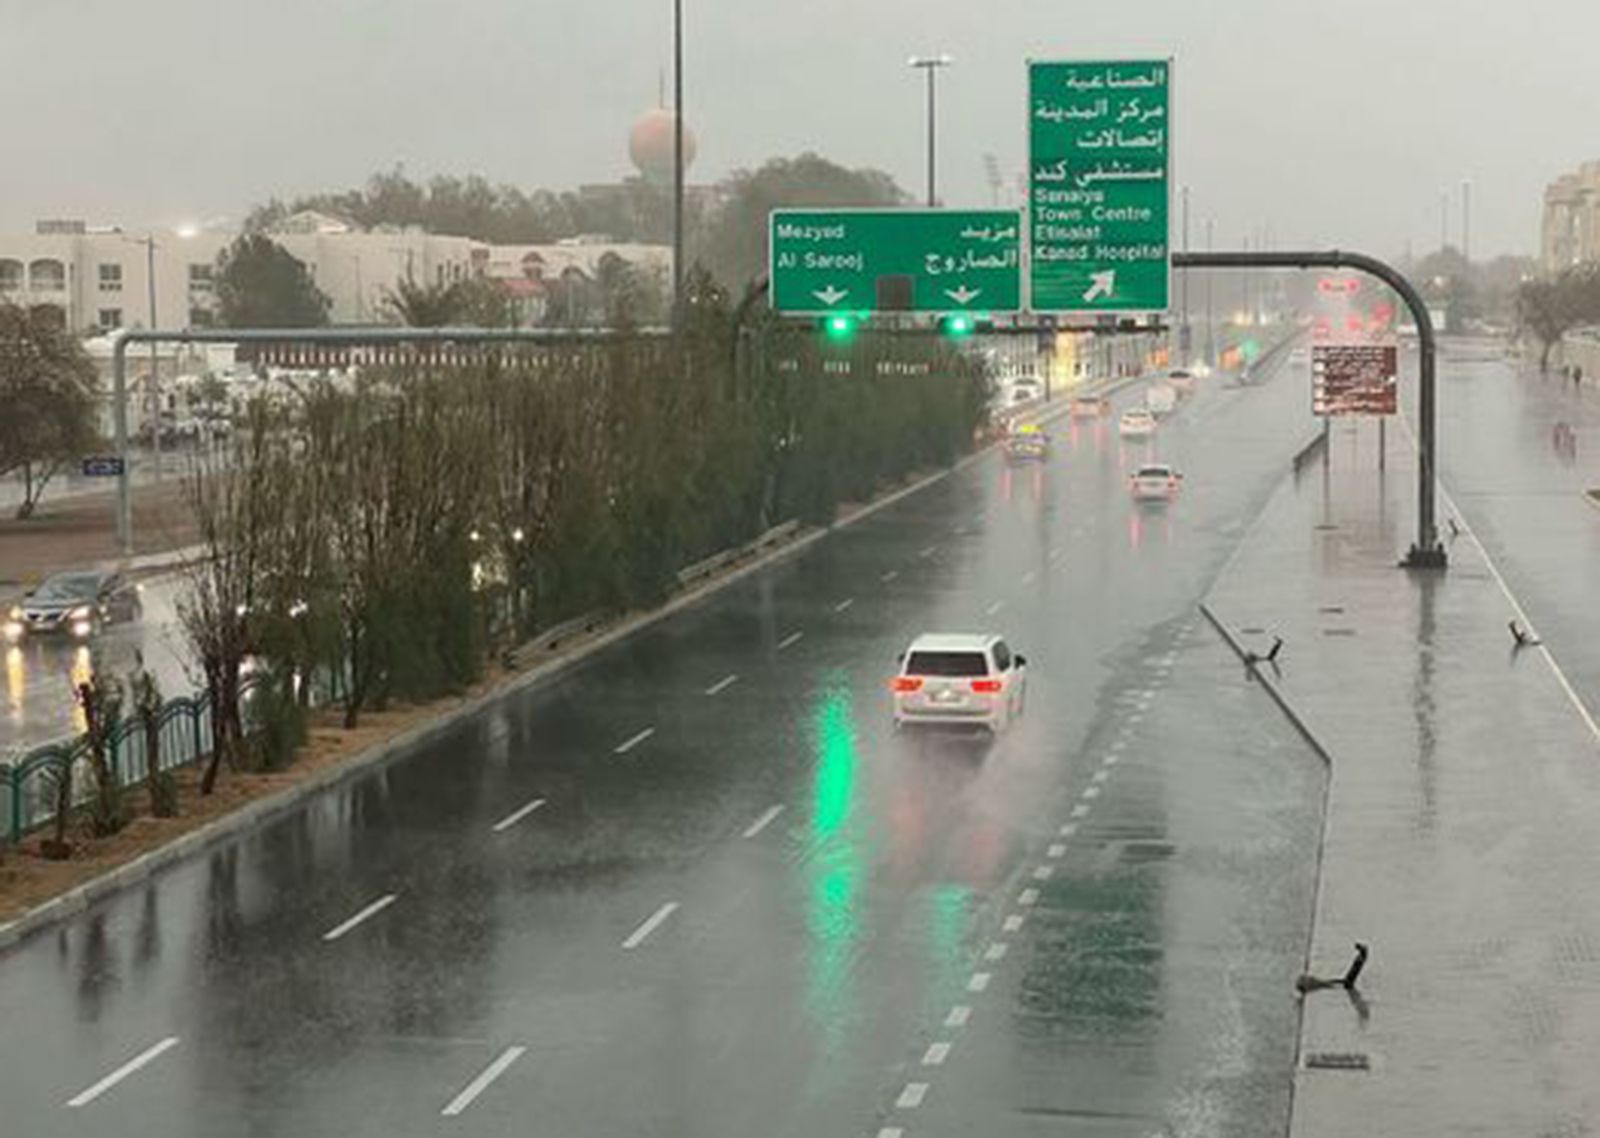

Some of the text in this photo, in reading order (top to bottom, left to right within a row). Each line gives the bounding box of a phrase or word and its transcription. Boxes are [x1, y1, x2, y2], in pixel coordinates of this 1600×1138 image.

[1035, 99, 1163, 122] مركز المدينة
[1035, 207, 1151, 221] Town Centre
[777, 224, 845, 242] Mezyad
[960, 223, 1015, 241] مزيد
[1035, 225, 1101, 240] Etisalat
[777, 252, 863, 270] Al Sarooj
[925, 249, 1017, 274] الصاروج
[1095, 244, 1164, 262] Hospital
